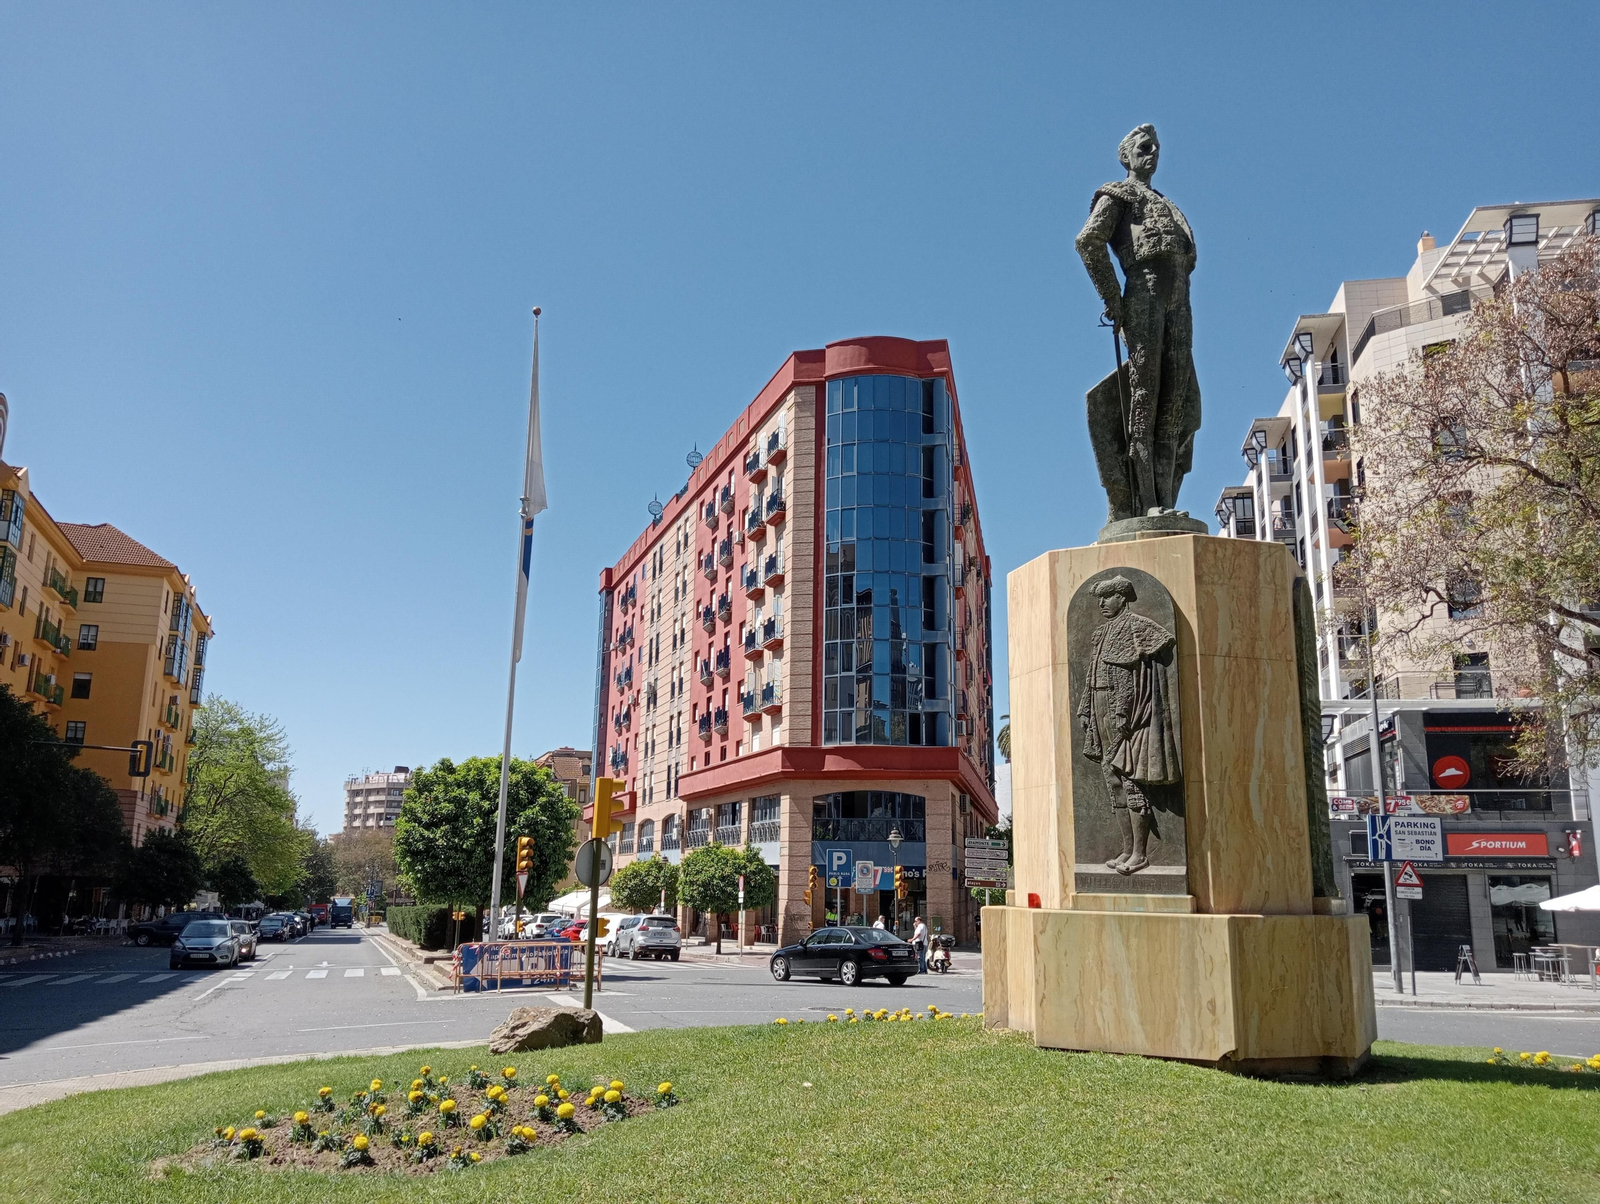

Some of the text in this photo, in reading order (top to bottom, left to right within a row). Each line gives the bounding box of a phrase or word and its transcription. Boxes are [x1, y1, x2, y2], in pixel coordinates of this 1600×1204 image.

[1394, 821, 1436, 829] PARKING
[1464, 838, 1527, 851] SPORTIUM
[832, 851, 847, 871] P
